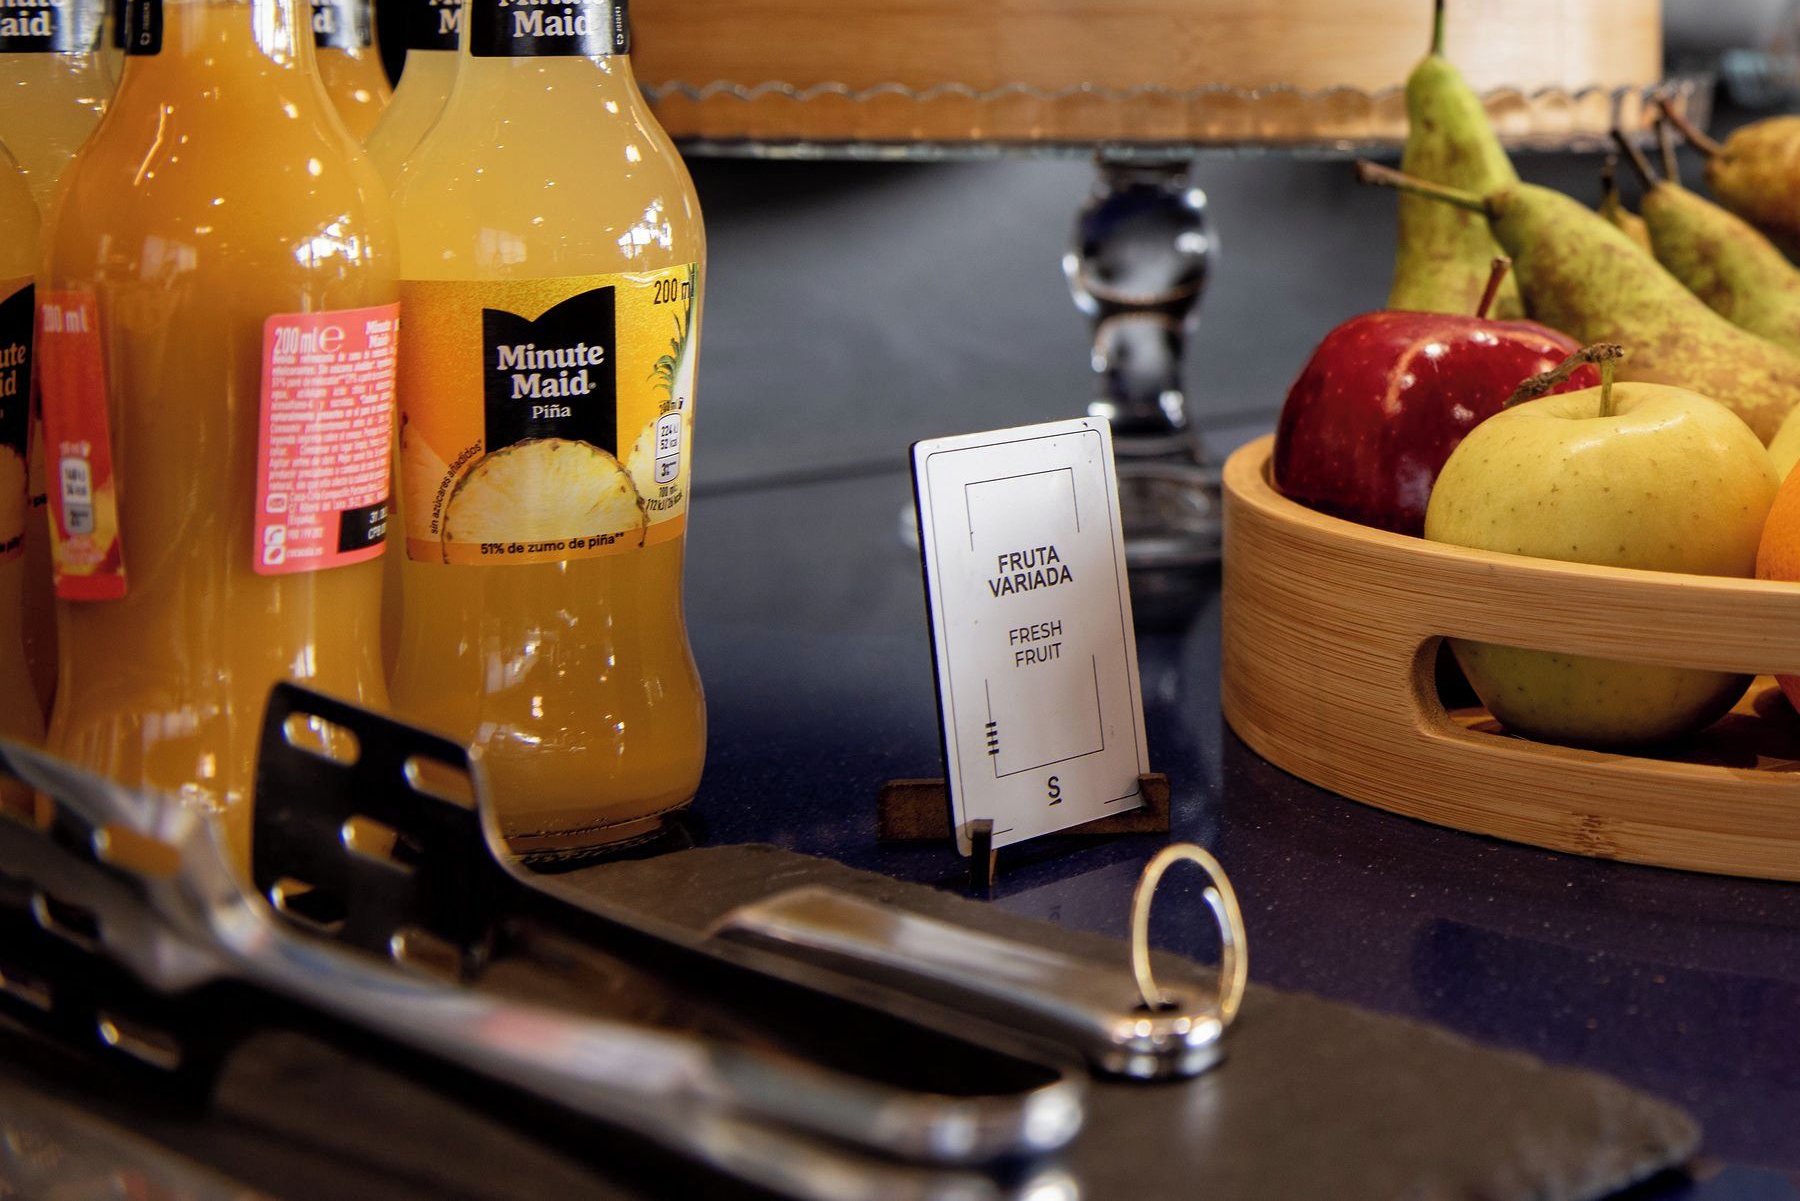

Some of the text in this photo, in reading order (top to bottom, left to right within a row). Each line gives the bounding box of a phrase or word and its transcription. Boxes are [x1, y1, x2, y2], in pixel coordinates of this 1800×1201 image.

[0, 10, 53, 37] aid
[513, 8, 592, 38] Maid
[654, 278, 678, 305] 200
[273, 326, 299, 355] 200
[496, 342, 605, 371] Minute
[511, 369, 591, 399] Maid
[532, 404, 572, 419] Piña
[432, 476, 451, 519] azúcares
[429, 520, 439, 535] sin
[481, 543, 504, 555] 51%
[507, 543, 524, 554] de
[528, 541, 565, 553] zumo
[568, 537, 585, 549] de
[998, 545, 1060, 574] FRUTA
[988, 565, 1073, 598] VARIADA
[1009, 620, 1062, 646] FRESH
[1015, 643, 1062, 668] FRUIT
